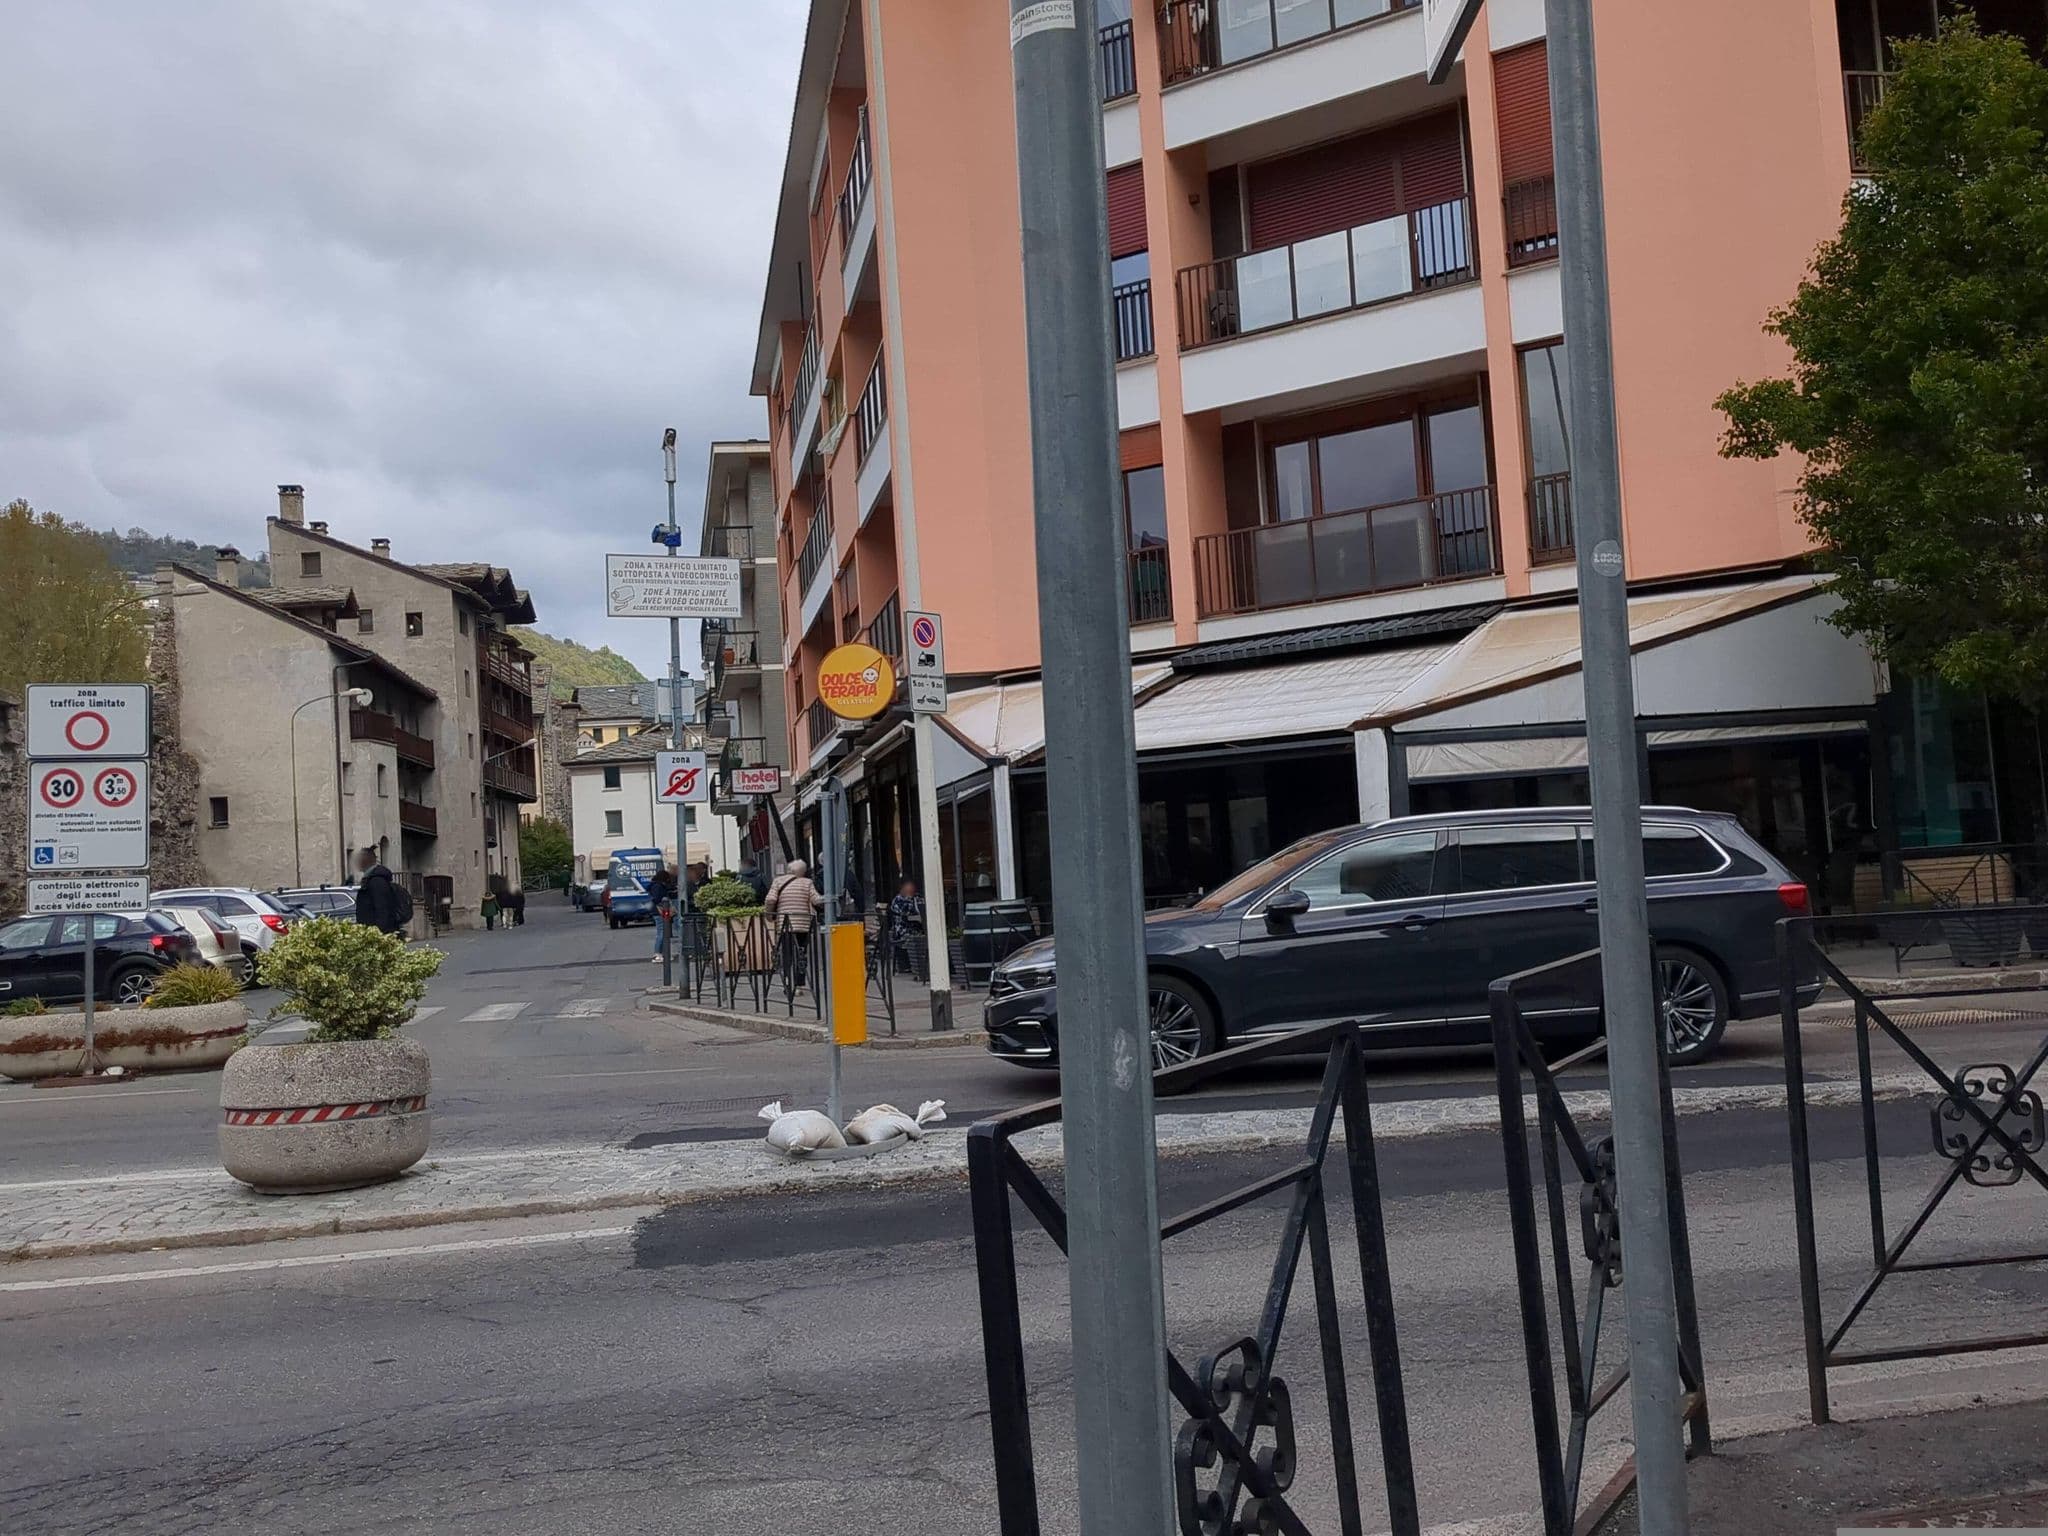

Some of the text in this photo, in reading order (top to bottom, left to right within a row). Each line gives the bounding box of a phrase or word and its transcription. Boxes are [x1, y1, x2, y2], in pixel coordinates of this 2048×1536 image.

[624, 561, 728, 571] ZONA A TRAFFICO LIMITATO
[612, 569, 662, 578] SOTTOPOSTA
[672, 571, 739, 581] VIDEOCONTROLLO
[643, 588, 663, 596] ZONE
[673, 588, 700, 597] TRAFIC
[702, 588, 727, 598] LIMITÉ
[642, 597, 729, 606] AVEC VIDÉO CONTRÔLE
[821, 671, 861, 686] DOLCE
[822, 683, 877, 699] TERAPIA
[50, 697, 126, 708] traffico limitato
[672, 756, 690, 764] zona
[741, 769, 777, 783] hotel
[51, 779, 75, 797] 30
[38, 881, 140, 890] controllo elettronico
[56, 890, 121, 900] degli accessi
[34, 902, 62, 910] accès
[66, 901, 93, 909] vidéo
